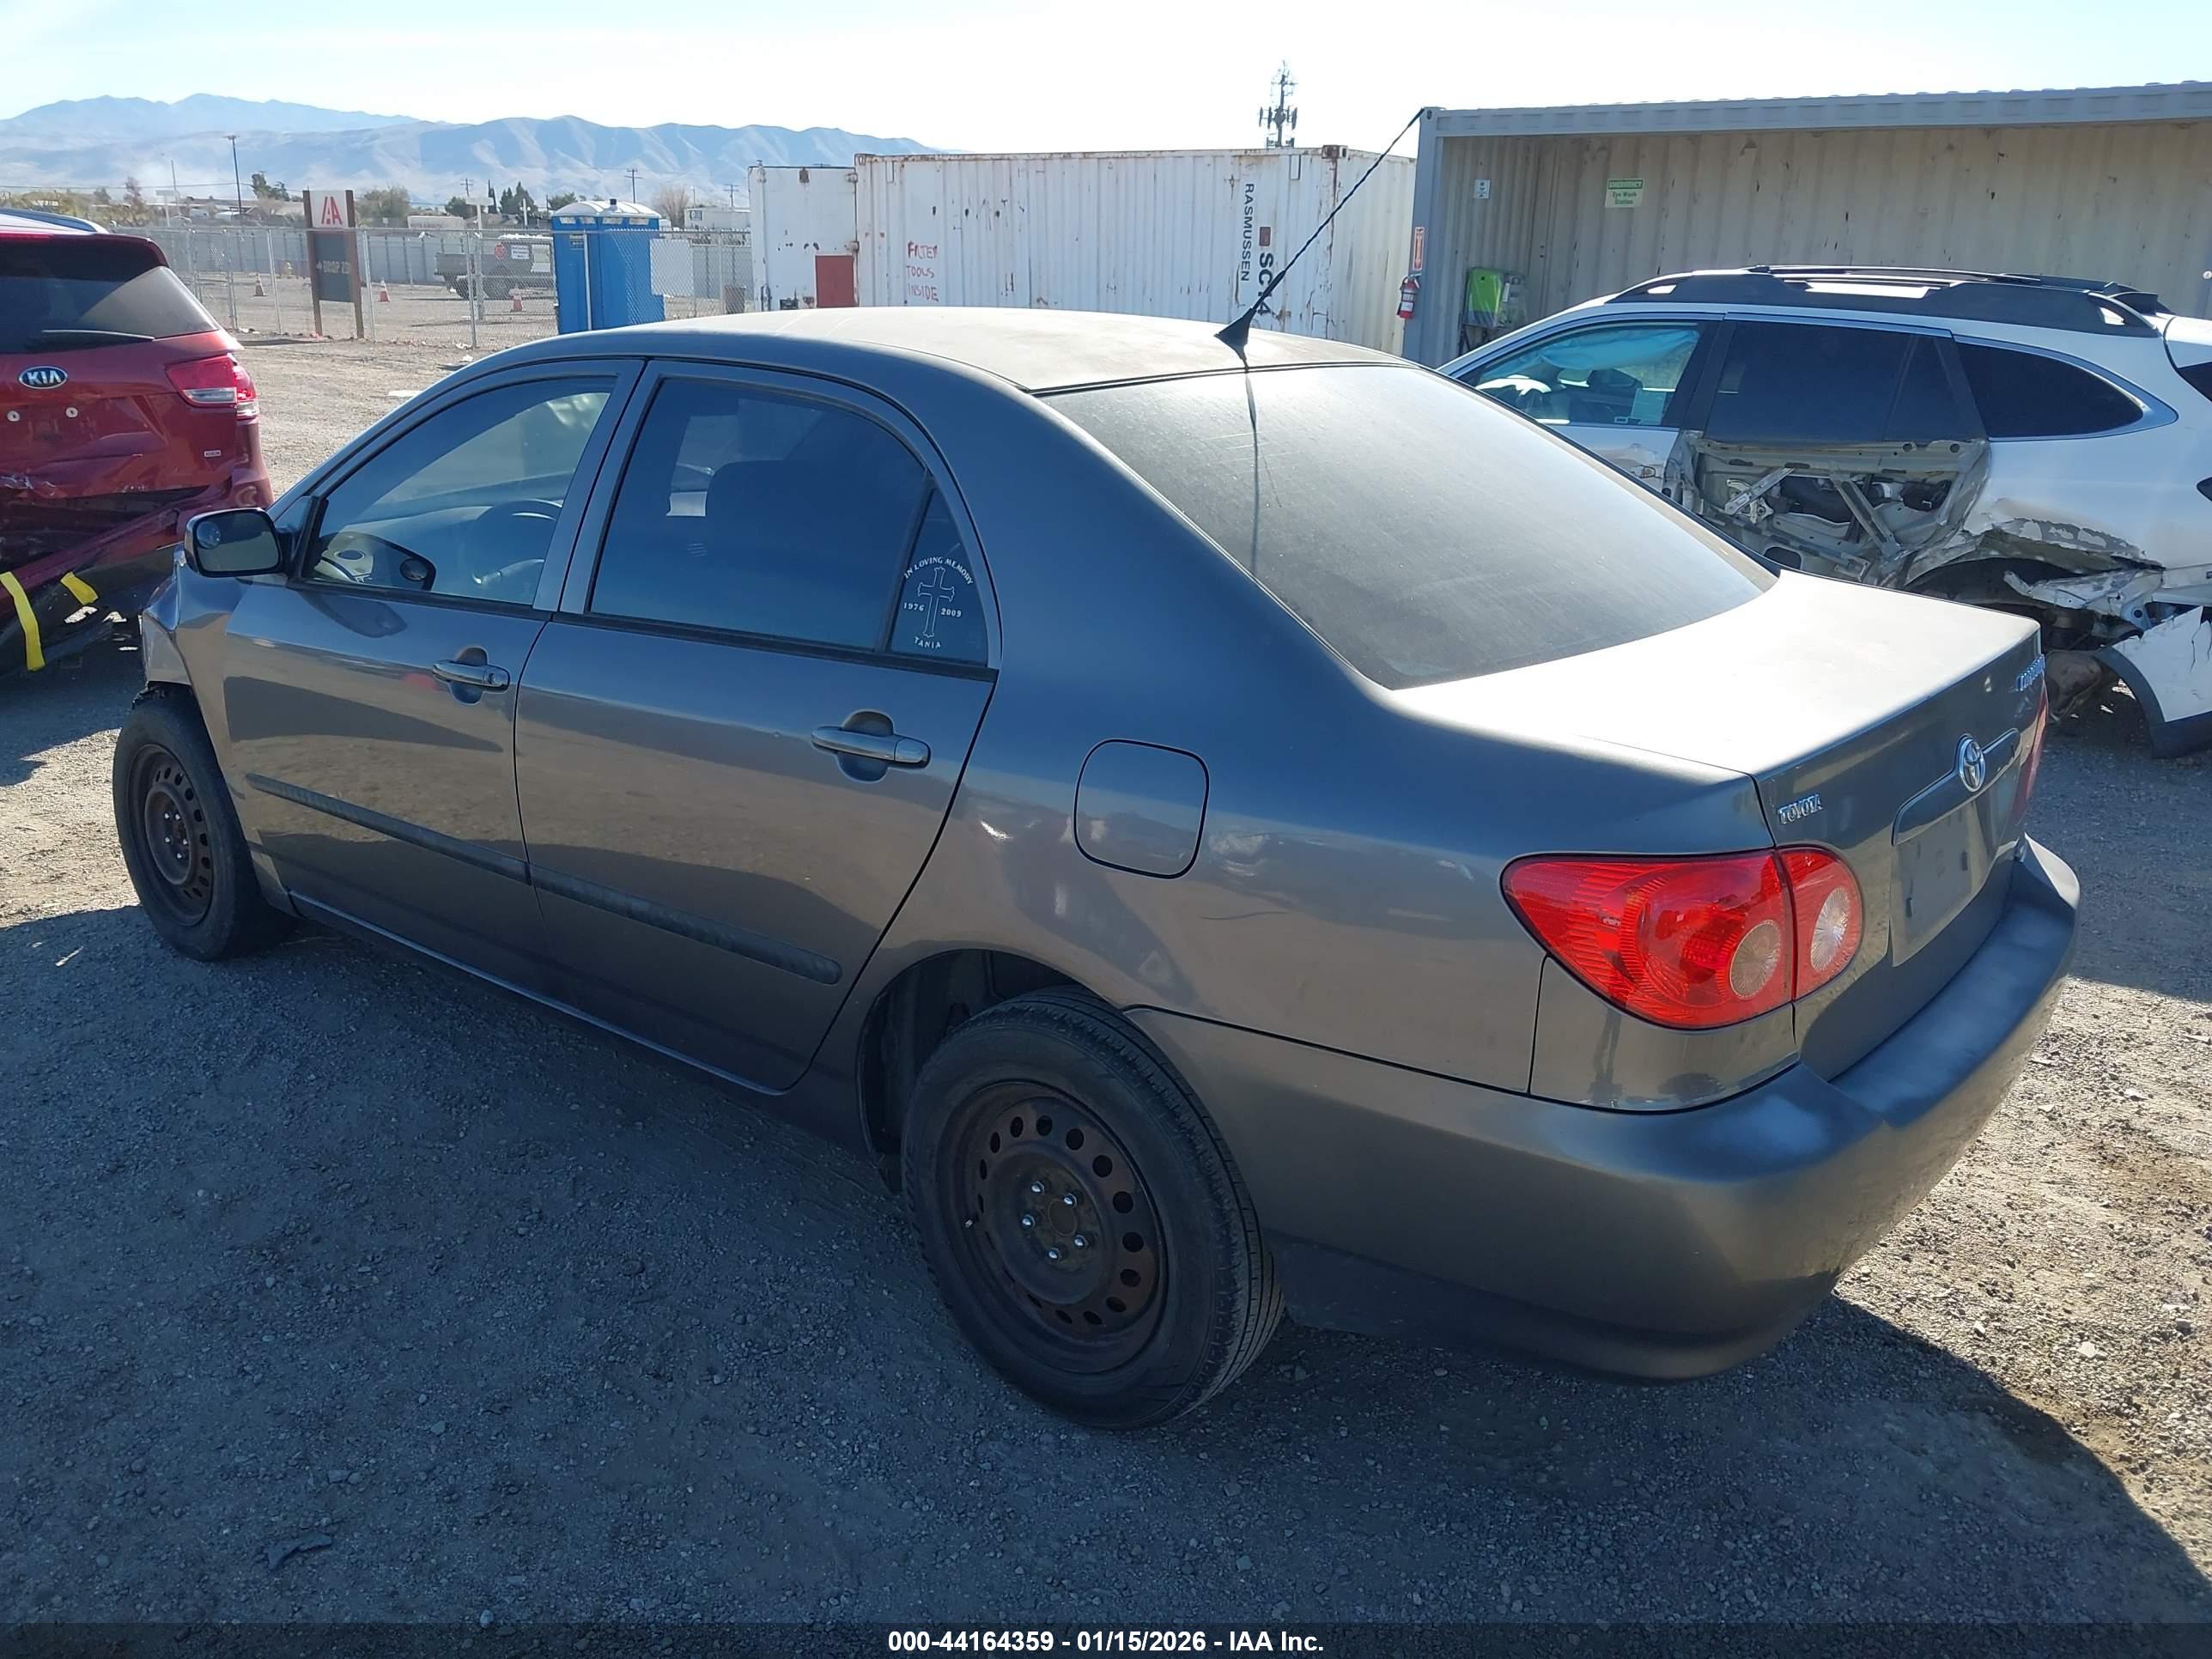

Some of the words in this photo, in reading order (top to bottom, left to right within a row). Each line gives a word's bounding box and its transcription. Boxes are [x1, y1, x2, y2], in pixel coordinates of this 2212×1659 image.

[1241, 183, 1255, 282] RASMUSSEN
[908, 240, 938, 259] FILTER
[907, 265, 934, 279] TOOLS
[908, 283, 939, 302] INSIDE
[26, 369, 64, 386] KIA
[903, 567, 914, 580] IN
[914, 556, 944, 571] LOVING
[945, 558, 974, 585] MEMORY
[903, 602, 926, 612] 1976
[940, 607, 963, 617] 2009
[914, 636, 942, 649] TANIA
[1779, 793, 1823, 824] TOYOTA
